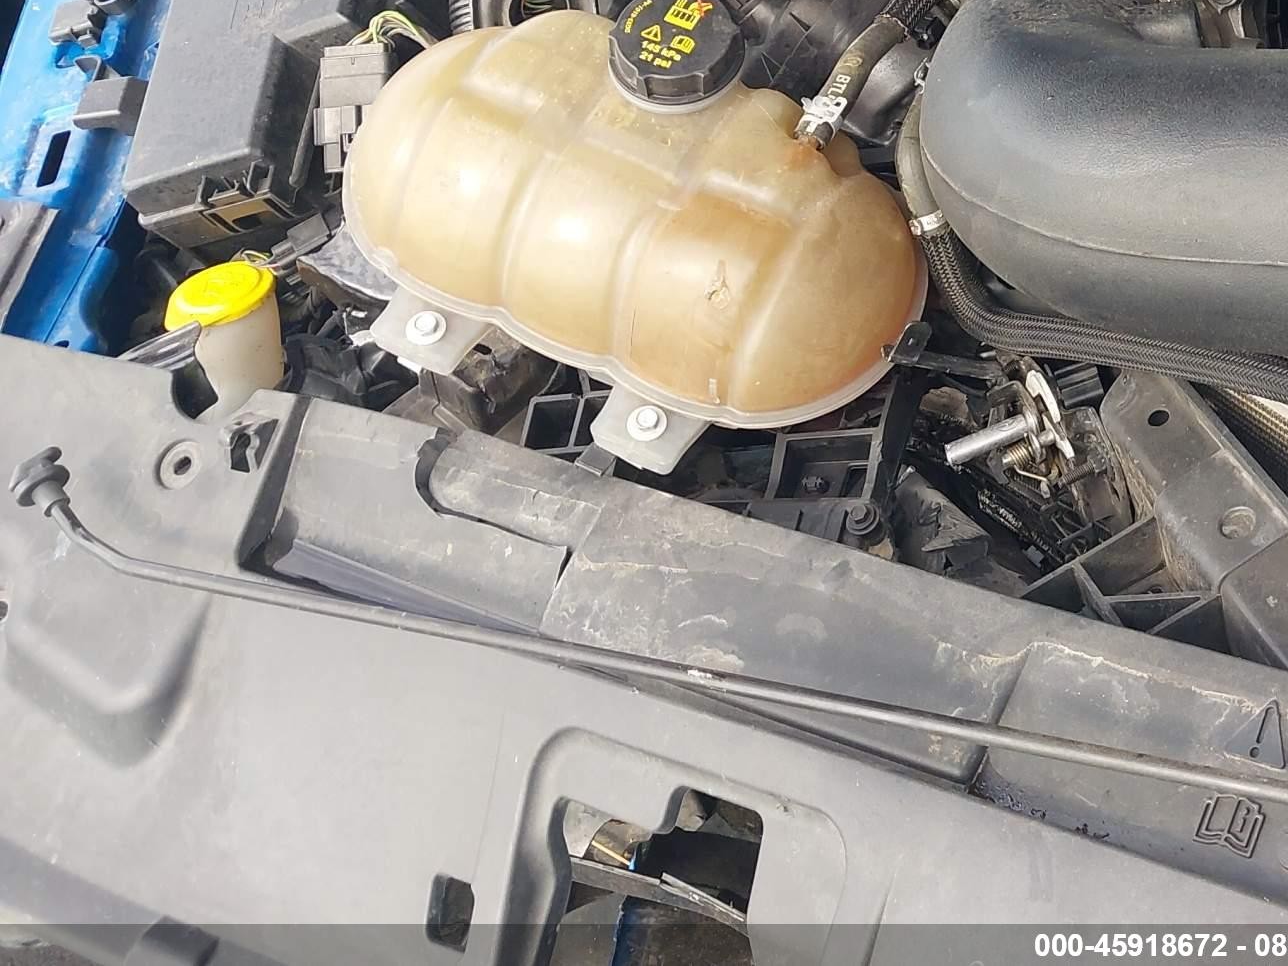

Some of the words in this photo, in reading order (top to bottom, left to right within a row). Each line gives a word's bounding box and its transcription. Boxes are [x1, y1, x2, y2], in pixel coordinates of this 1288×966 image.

[639, 51, 654, 62] 21
[653, 57, 673, 69] psi
[641, 40, 661, 53] 145
[661, 47, 682, 62] kPa
